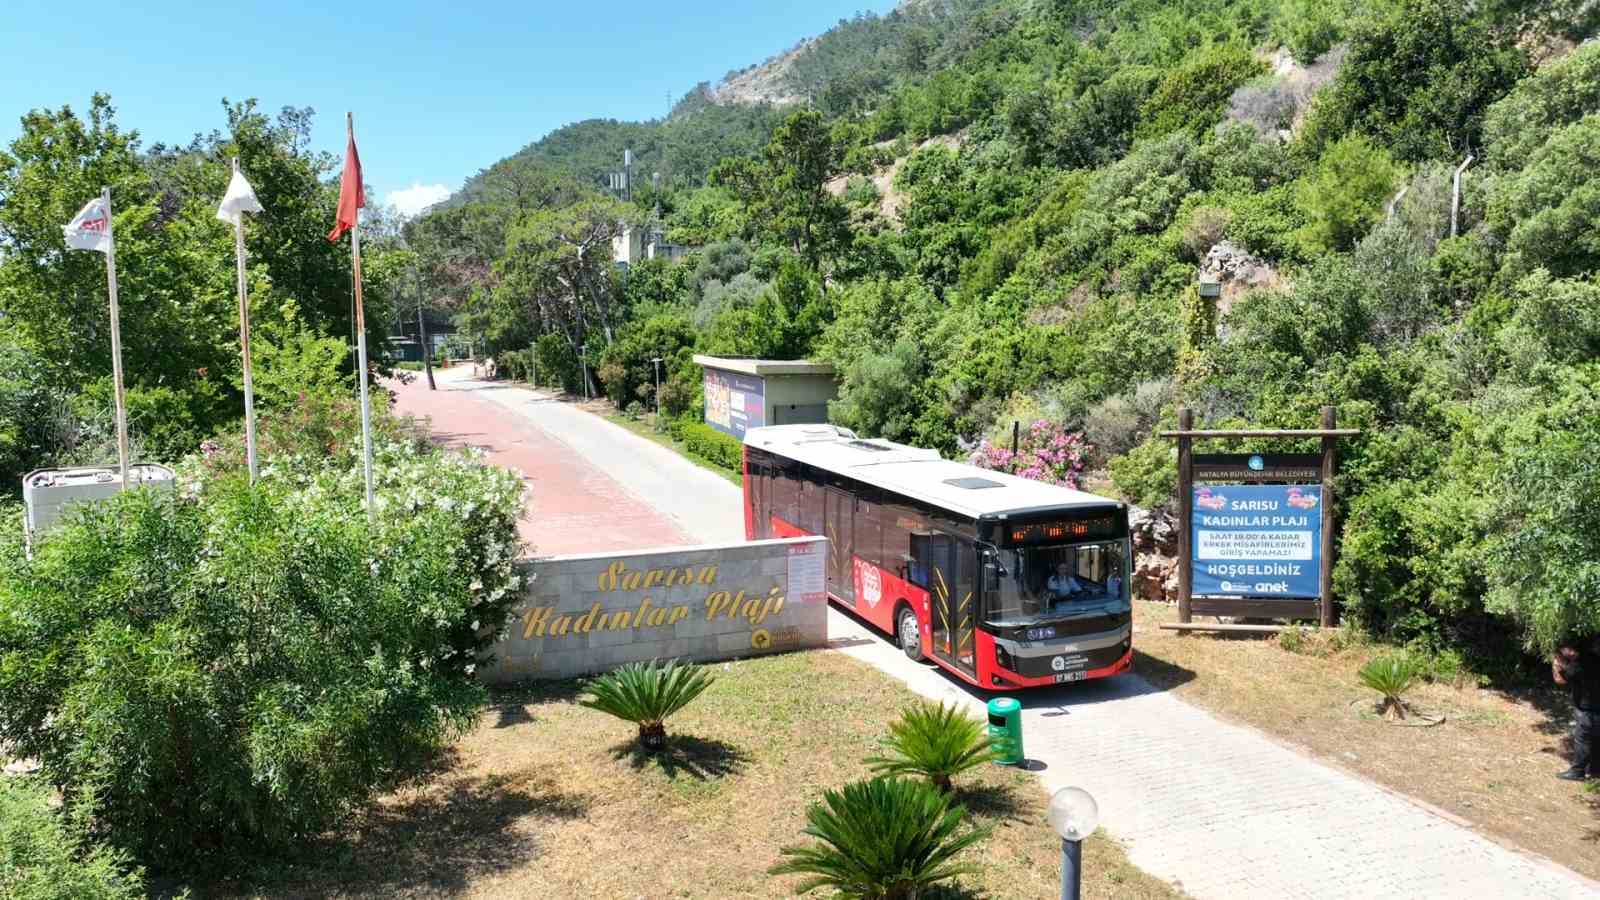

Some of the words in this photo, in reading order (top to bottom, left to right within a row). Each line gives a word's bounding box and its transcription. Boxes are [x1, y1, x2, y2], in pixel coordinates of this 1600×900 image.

[1231, 500, 1279, 511] SARISU
[1203, 516, 1270, 526] KADINLAR
[1272, 516, 1308, 526] PLAJI
[1208, 563, 1302, 577] HOŞGELDİNİZ
[1255, 581, 1289, 592] anet
